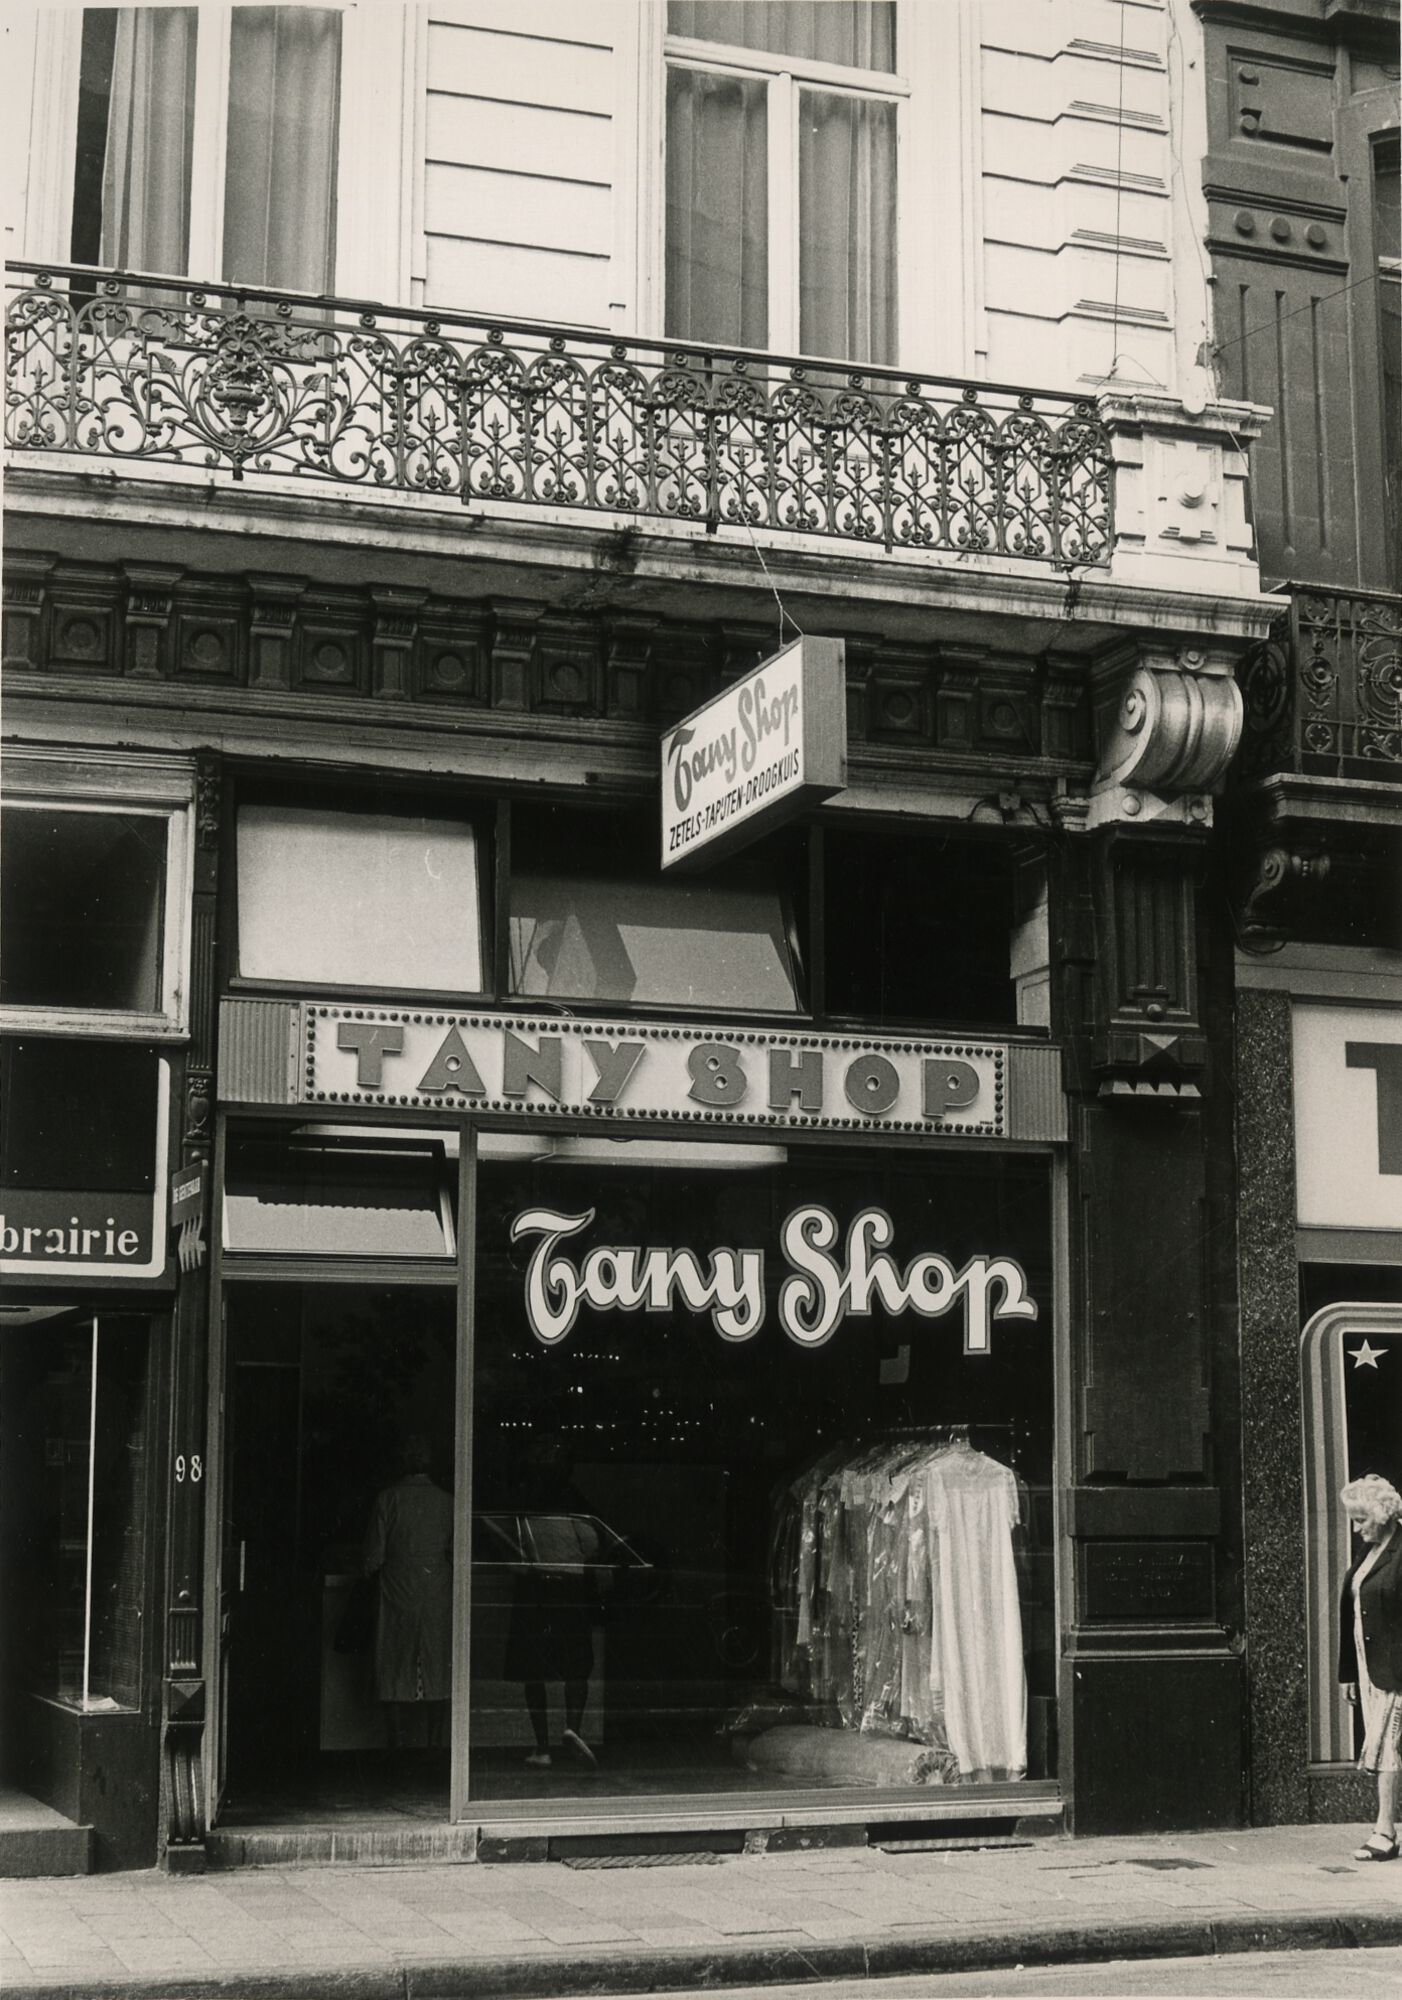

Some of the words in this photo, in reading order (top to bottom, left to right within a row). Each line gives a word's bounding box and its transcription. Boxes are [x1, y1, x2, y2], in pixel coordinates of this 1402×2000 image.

[667, 727, 737, 813] Tany
[738, 678, 799, 773] Shop
[337, 1022, 647, 1102] TANY
[687, 1043, 981, 1118] SHOP
[511, 1207, 765, 1345] Tany
[778, 1203, 1038, 1355] Shop
[175, 1454, 203, 1483] 98
